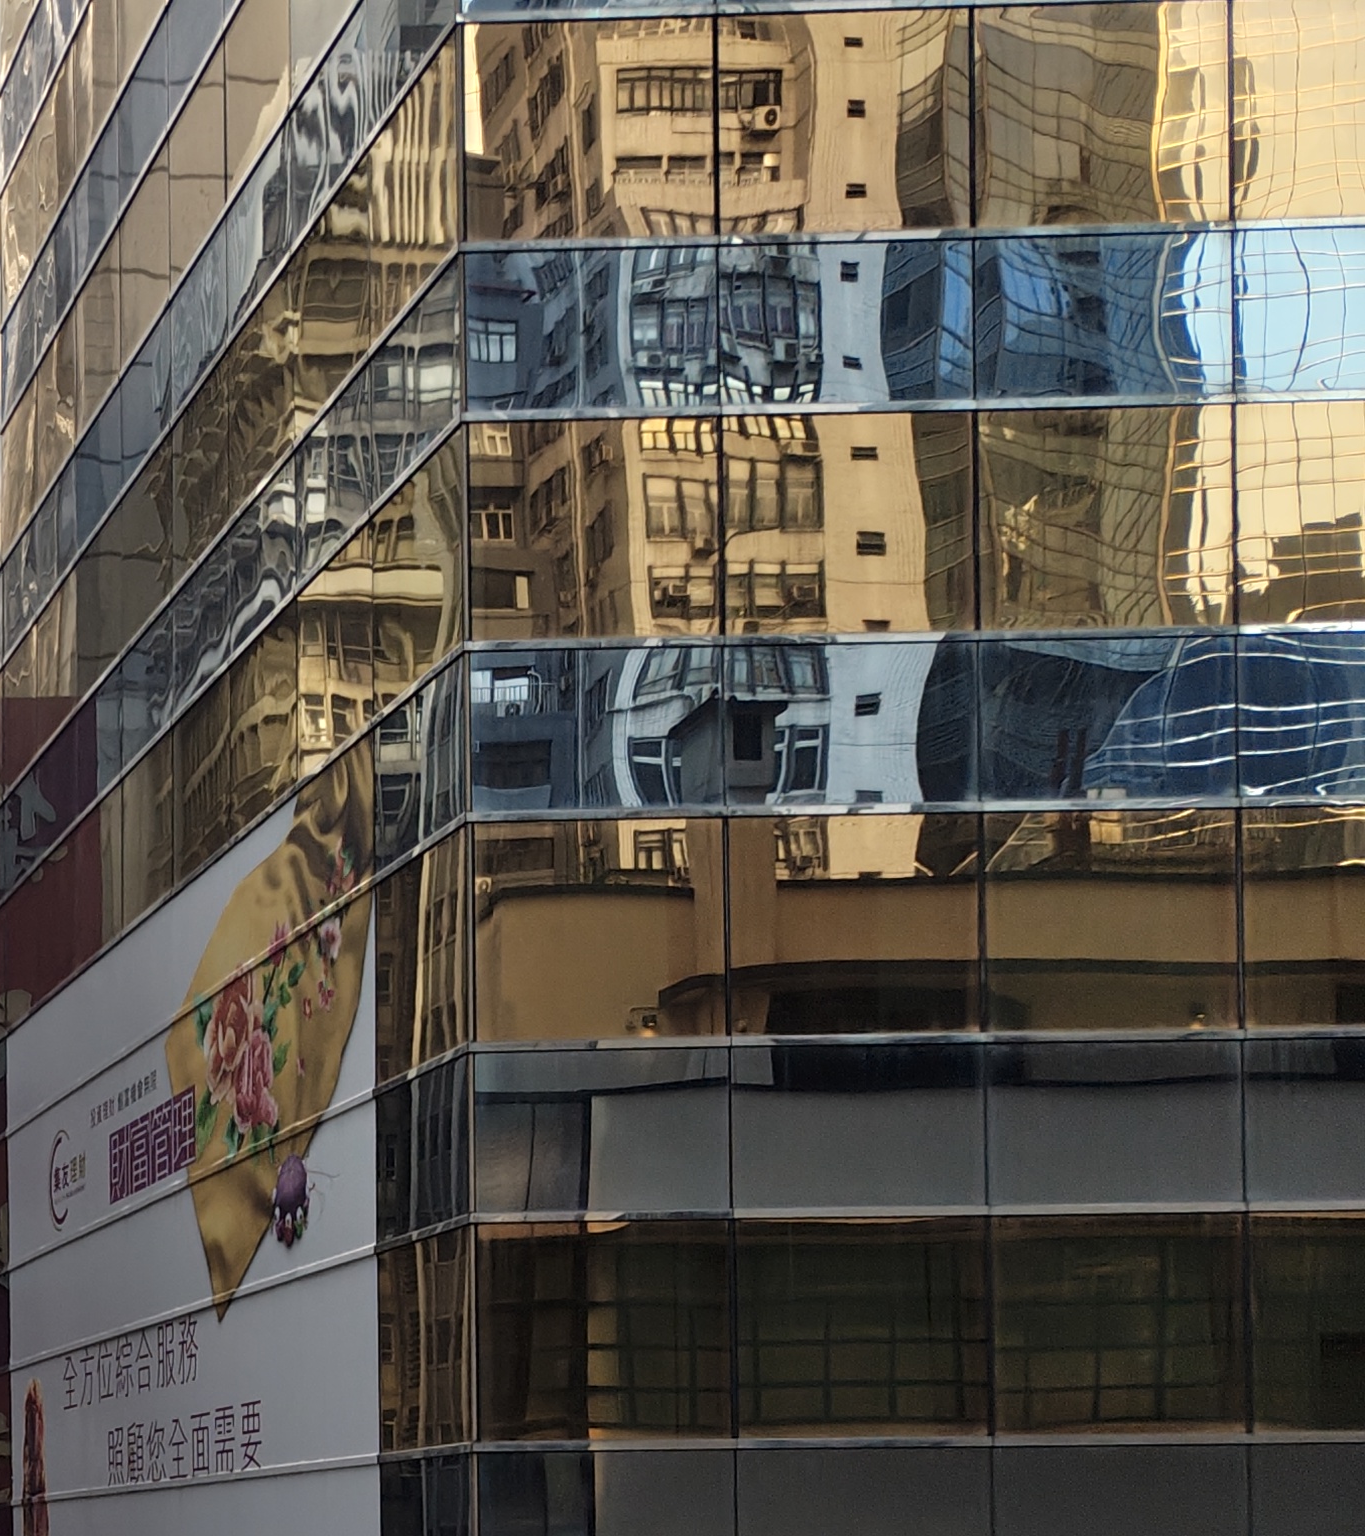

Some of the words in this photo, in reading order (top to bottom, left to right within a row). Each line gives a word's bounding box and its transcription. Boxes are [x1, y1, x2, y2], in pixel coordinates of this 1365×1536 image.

[110, 1089, 197, 1201] 財富管理
[63, 1314, 199, 1411] 全方位綜合服務
[107, 1399, 263, 1487] 照顧您全面需要
